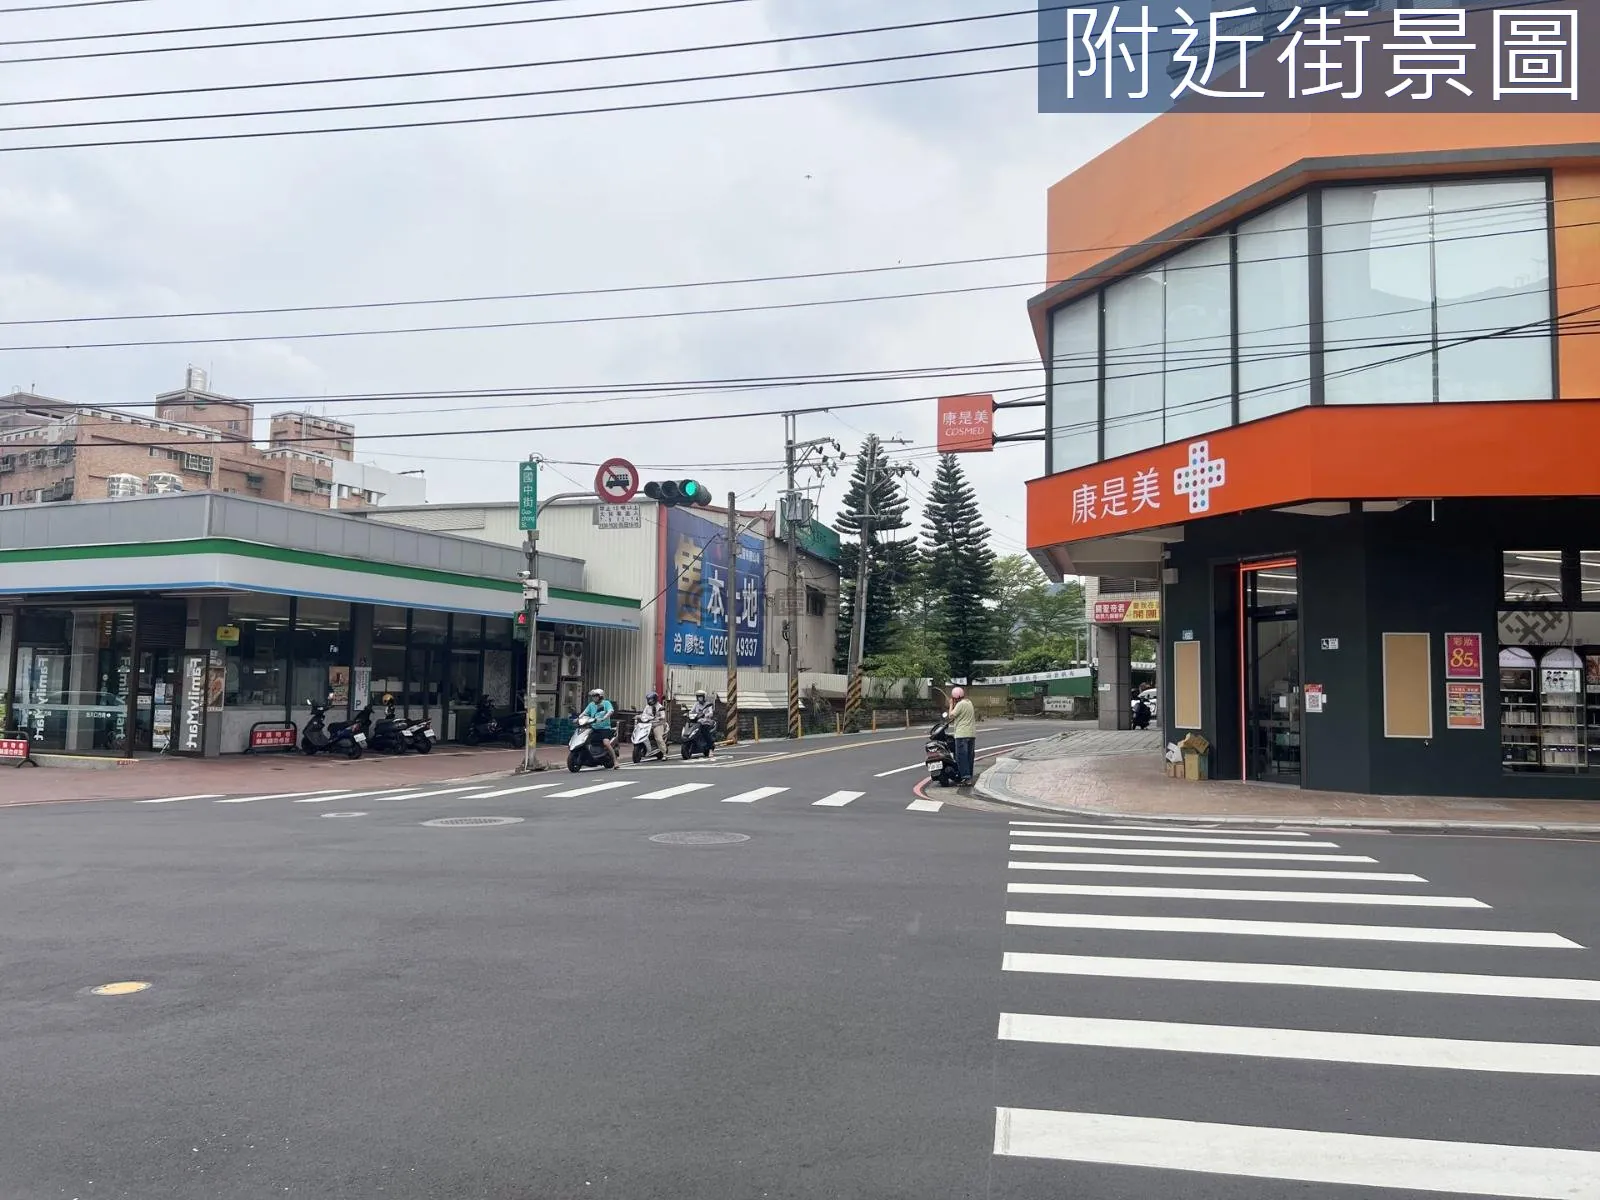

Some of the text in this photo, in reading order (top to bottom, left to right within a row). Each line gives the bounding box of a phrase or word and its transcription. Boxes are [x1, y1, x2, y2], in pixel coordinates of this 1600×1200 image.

[943, 410, 989, 425] 康是美
[945, 426, 985, 437] COSMED
[523, 471, 533, 509] 國中街
[1071, 467, 1160, 524] 康是美
[709, 634, 758, 657] 092049337
[1450, 647, 1474, 668] 85
